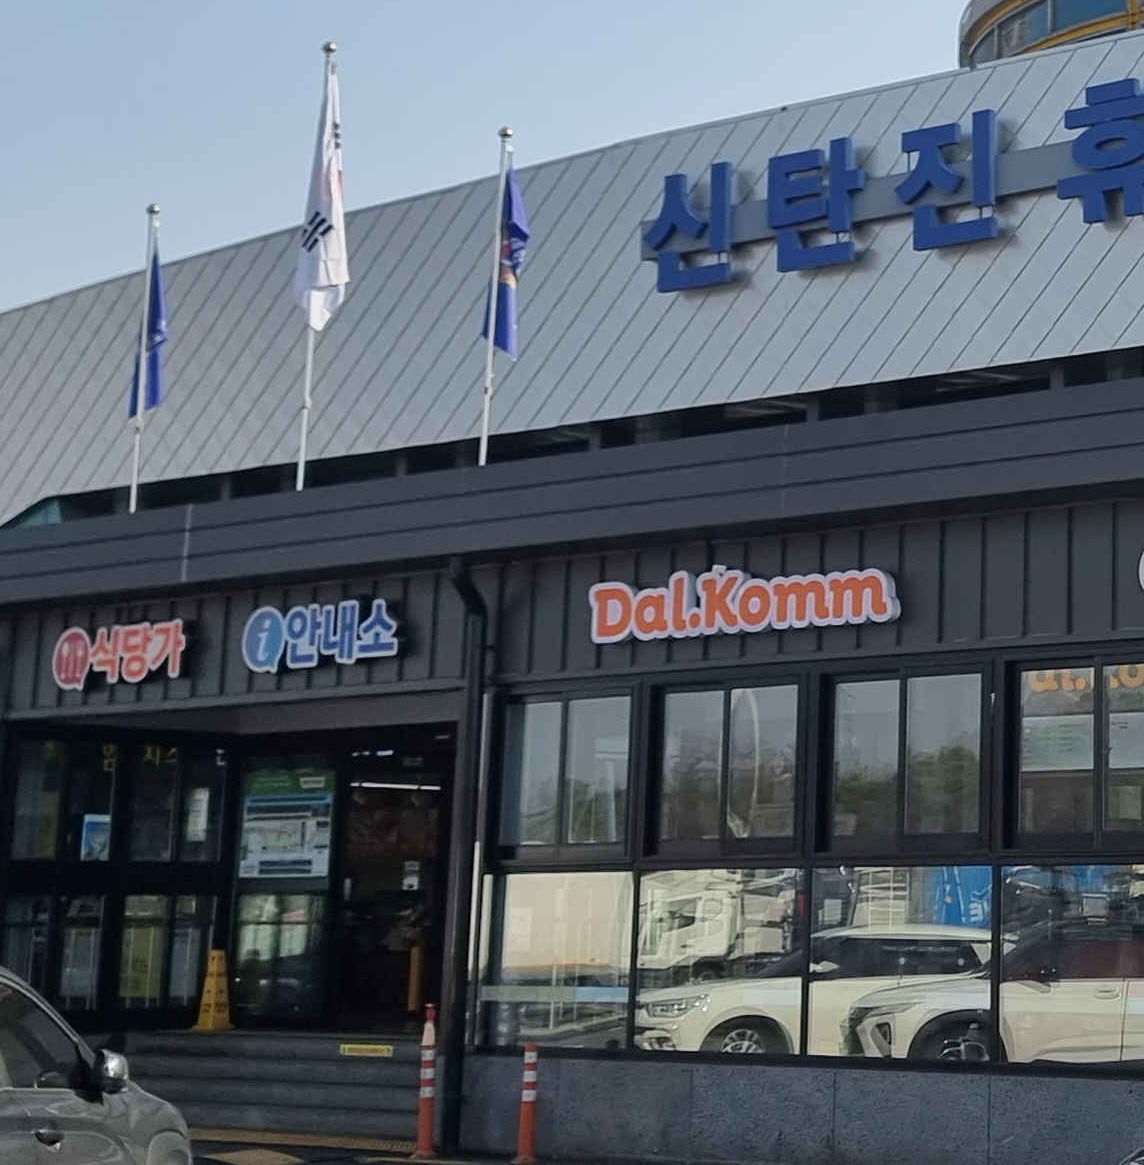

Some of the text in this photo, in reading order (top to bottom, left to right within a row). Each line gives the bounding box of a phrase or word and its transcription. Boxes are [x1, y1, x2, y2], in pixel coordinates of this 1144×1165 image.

[286, 600, 398, 666] 안내소
[594, 571, 889, 637] Dal.Komm
[91, 620, 185, 682] 식당가
